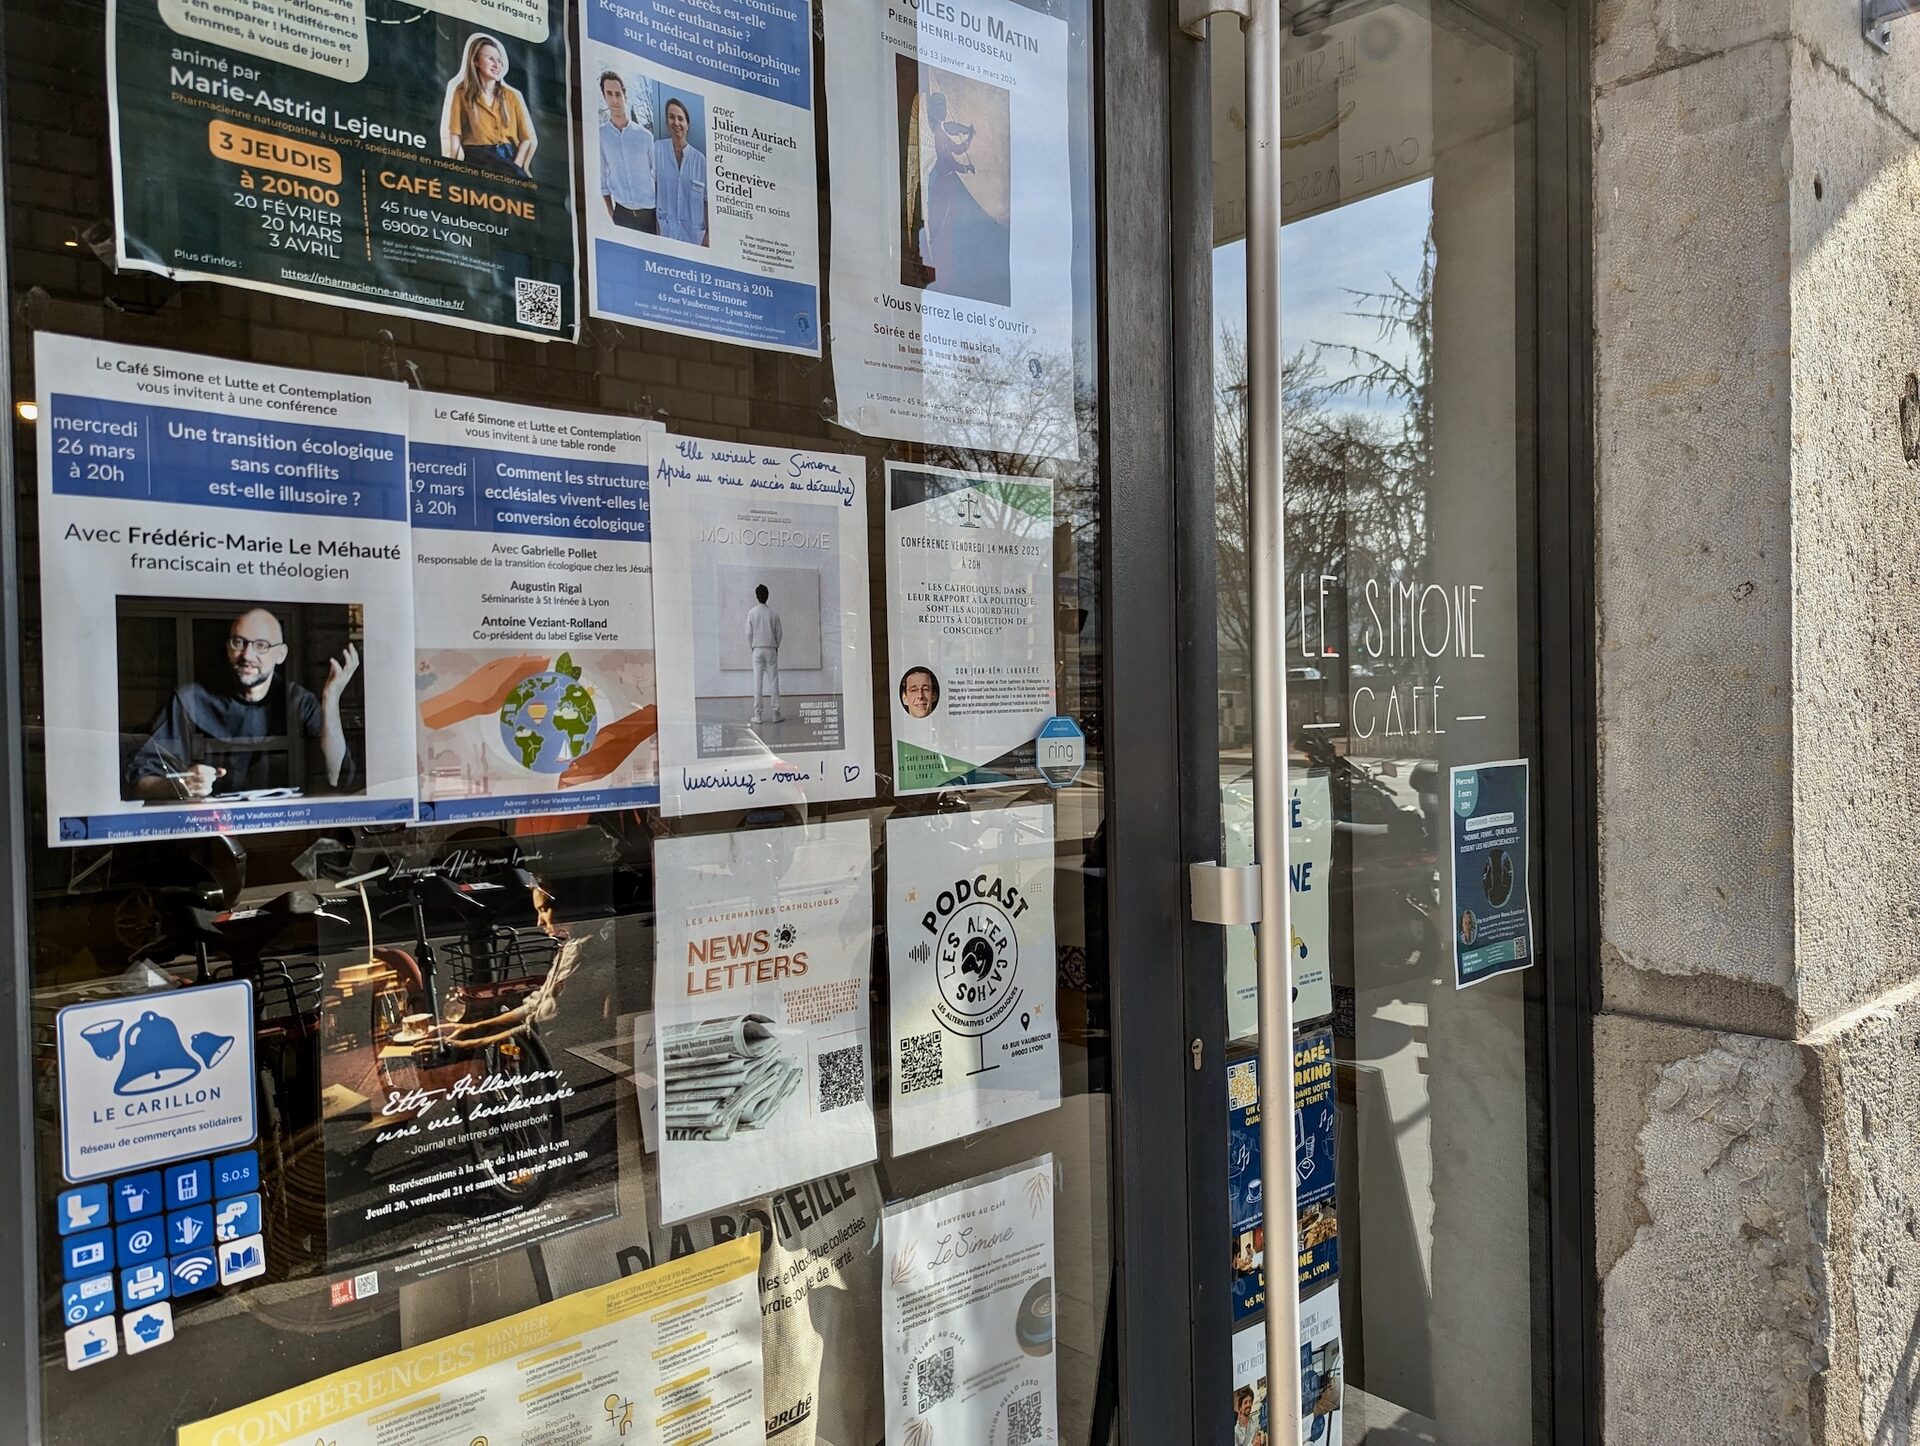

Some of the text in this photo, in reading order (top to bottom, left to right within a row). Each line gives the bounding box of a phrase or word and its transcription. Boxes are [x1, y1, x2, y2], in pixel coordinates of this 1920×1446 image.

[185, 11, 244, 38] femmes,
[214, 4, 270, 30] emparer
[498, 3, 534, 22] ringard
[724, 10, 766, 30] est-elle
[960, 12, 981, 32] DU
[678, 12, 743, 40] euthanasie
[921, 22, 1012, 63] HENRI-ROUSSEAU
[172, 48, 261, 81] animé par
[696, 54, 780, 88] contemporain
[717, 41, 801, 76] philosophique
[880, 32, 1017, 86] Exposition janvier 2025
[170, 66, 426, 149] Marie-Astrid Lejeune
[712, 105, 734, 119] avec
[172, 92, 538, 190] Pharmacienne naturopathe fonctionnelle
[712, 116, 797, 150] Julien Auriach
[240, 137, 332, 174] JEUDIS
[714, 142, 766, 163] philosophie
[262, 175, 340, 207] 20h00
[715, 166, 776, 191] Geneviève
[716, 180, 752, 199] Gridel
[380, 171, 536, 220] CAFÉ SIMONE
[716, 194, 754, 210] médecin
[263, 199, 342, 227] FÉVRIER
[430, 210, 509, 236] Vaubecour
[716, 205, 754, 221] palliatifs
[290, 220, 343, 243] MARS
[382, 220, 472, 248] 69002 LYON
[284, 236, 340, 259] AVRIL
[281, 268, 464, 310] https://pharmacienne-naturopathe.fr/
[644, 260, 774, 298] Mercredi 20h
[682, 297, 719, 313] Vaubecour
[712, 292, 748, 308] Simone
[882, 293, 950, 320] Vous verrez
[874, 323, 1000, 355] Soirée cloture musicale
[152, 366, 372, 405] Simone Contemplation
[174, 384, 338, 416] invitent conférence
[54, 416, 138, 438] mercredi
[570, 427, 642, 442] Contemplation
[58, 438, 136, 460] 26 mars
[168, 422, 394, 462] Une transition écologique
[560, 438, 585, 450] table
[274, 462, 340, 481] conflits
[676, 440, 841, 478] Elle revient Simone
[88, 464, 124, 482] 20h
[496, 463, 562, 482] Comment
[657, 458, 691, 488] Après
[750, 475, 785, 490] succès
[208, 482, 348, 506] est-elle illusoire
[485, 487, 636, 510] ecclésiales vivent-elles
[428, 501, 456, 516] 20h
[497, 510, 644, 532] conversion écologique
[64, 523, 401, 560] Avec Frédéric-Marie Méhauté
[701, 526, 831, 550] MONOCHROME
[901, 536, 1018, 554] CONFÉRENCE VENDREDI MARS
[418, 555, 478, 566] Responsable
[522, 546, 565, 558] Gabrielle
[131, 553, 350, 582] franciscain théologien
[510, 581, 556, 594] Augustin
[933, 594, 970, 603] RAPPORT
[945, 584, 1001, 595] CATHOLIQUES,
[481, 594, 610, 608] Séminariste Lyon
[481, 616, 608, 628] Antoine Veziant-Rolland
[1301, 573, 1485, 658] LE SIMONE
[472, 630, 532, 642] Co-président
[944, 626, 993, 634] CONSCIENCE
[1353, 676, 1446, 738] CAFÉ
[1048, 741, 1074, 762] ring
[686, 898, 840, 926] LES ALTERNATIVES CATHOLIQUES
[922, 874, 1028, 936] PODCAST
[688, 929, 770, 966] NEWS
[943, 932, 961, 979] LES
[968, 916, 1008, 956] ALTER
[687, 952, 809, 996] LETTERS
[945, 986, 1018, 1028] ALTERNATIVES CATHOLIQUES
[1021, 1033, 1052, 1046] VAUBECOUR
[1029, 1044, 1044, 1054] LYON
[94, 1086, 221, 1124] LE CARILLON
[382, 1088, 446, 1116] Etty
[80, 1114, 242, 1156] Réseau commerçants solidaires
[376, 1125, 420, 1143] une
[428, 1108, 462, 1129] vie
[411, 1114, 548, 1155] Journal Westerbork
[222, 1168, 250, 1182] S.O.S
[389, 1170, 456, 1194] Représentations
[365, 1188, 451, 1220] Jeudi vendredi
[828, 1216, 866, 1248] collectées
[936, 1210, 976, 1229] BIENVENUE
[928, 1226, 1014, 1270] Le Simone
[760, 1298, 792, 1316] vraie
[486, 1315, 548, 1344] JANVIER
[211, 1340, 476, 1446] CONFÉRENCES
